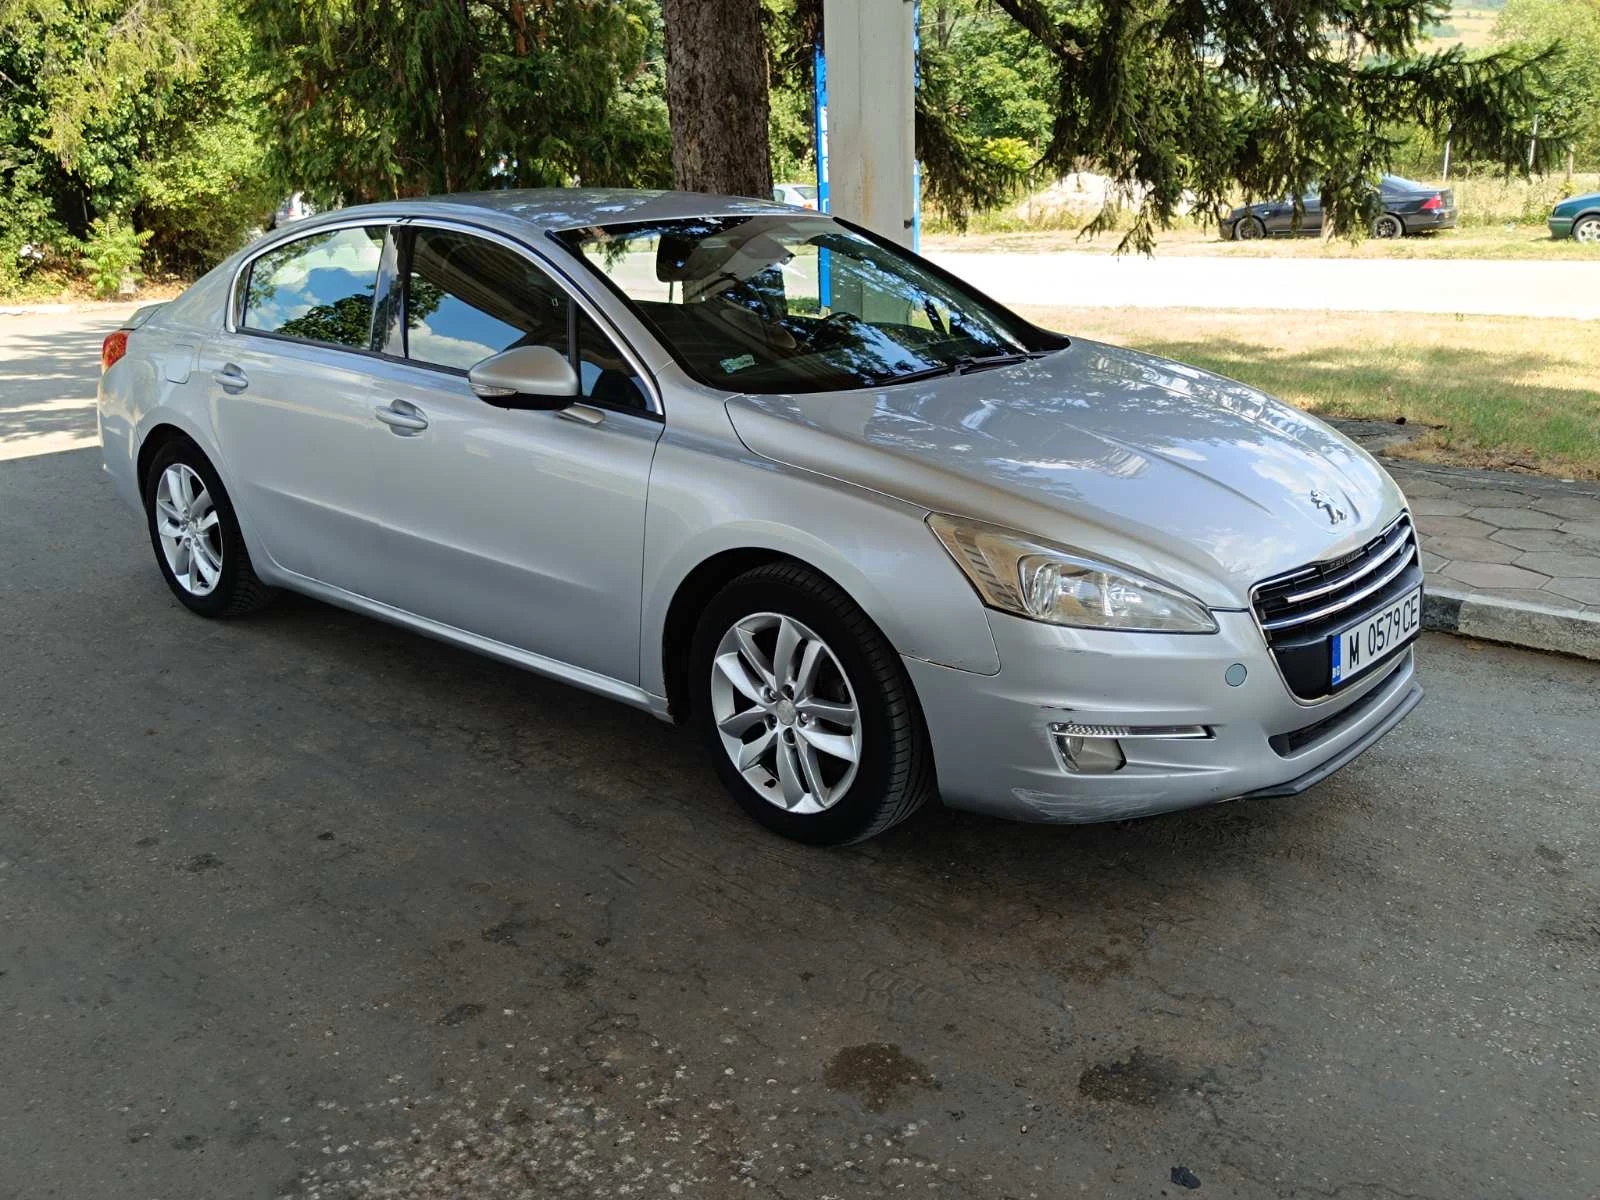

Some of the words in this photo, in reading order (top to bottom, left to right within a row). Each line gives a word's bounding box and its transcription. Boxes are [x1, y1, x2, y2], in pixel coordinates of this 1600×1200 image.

[1349, 631, 1360, 671] M
[1368, 606, 1401, 657] 0579
[1403, 594, 1418, 639] CE
